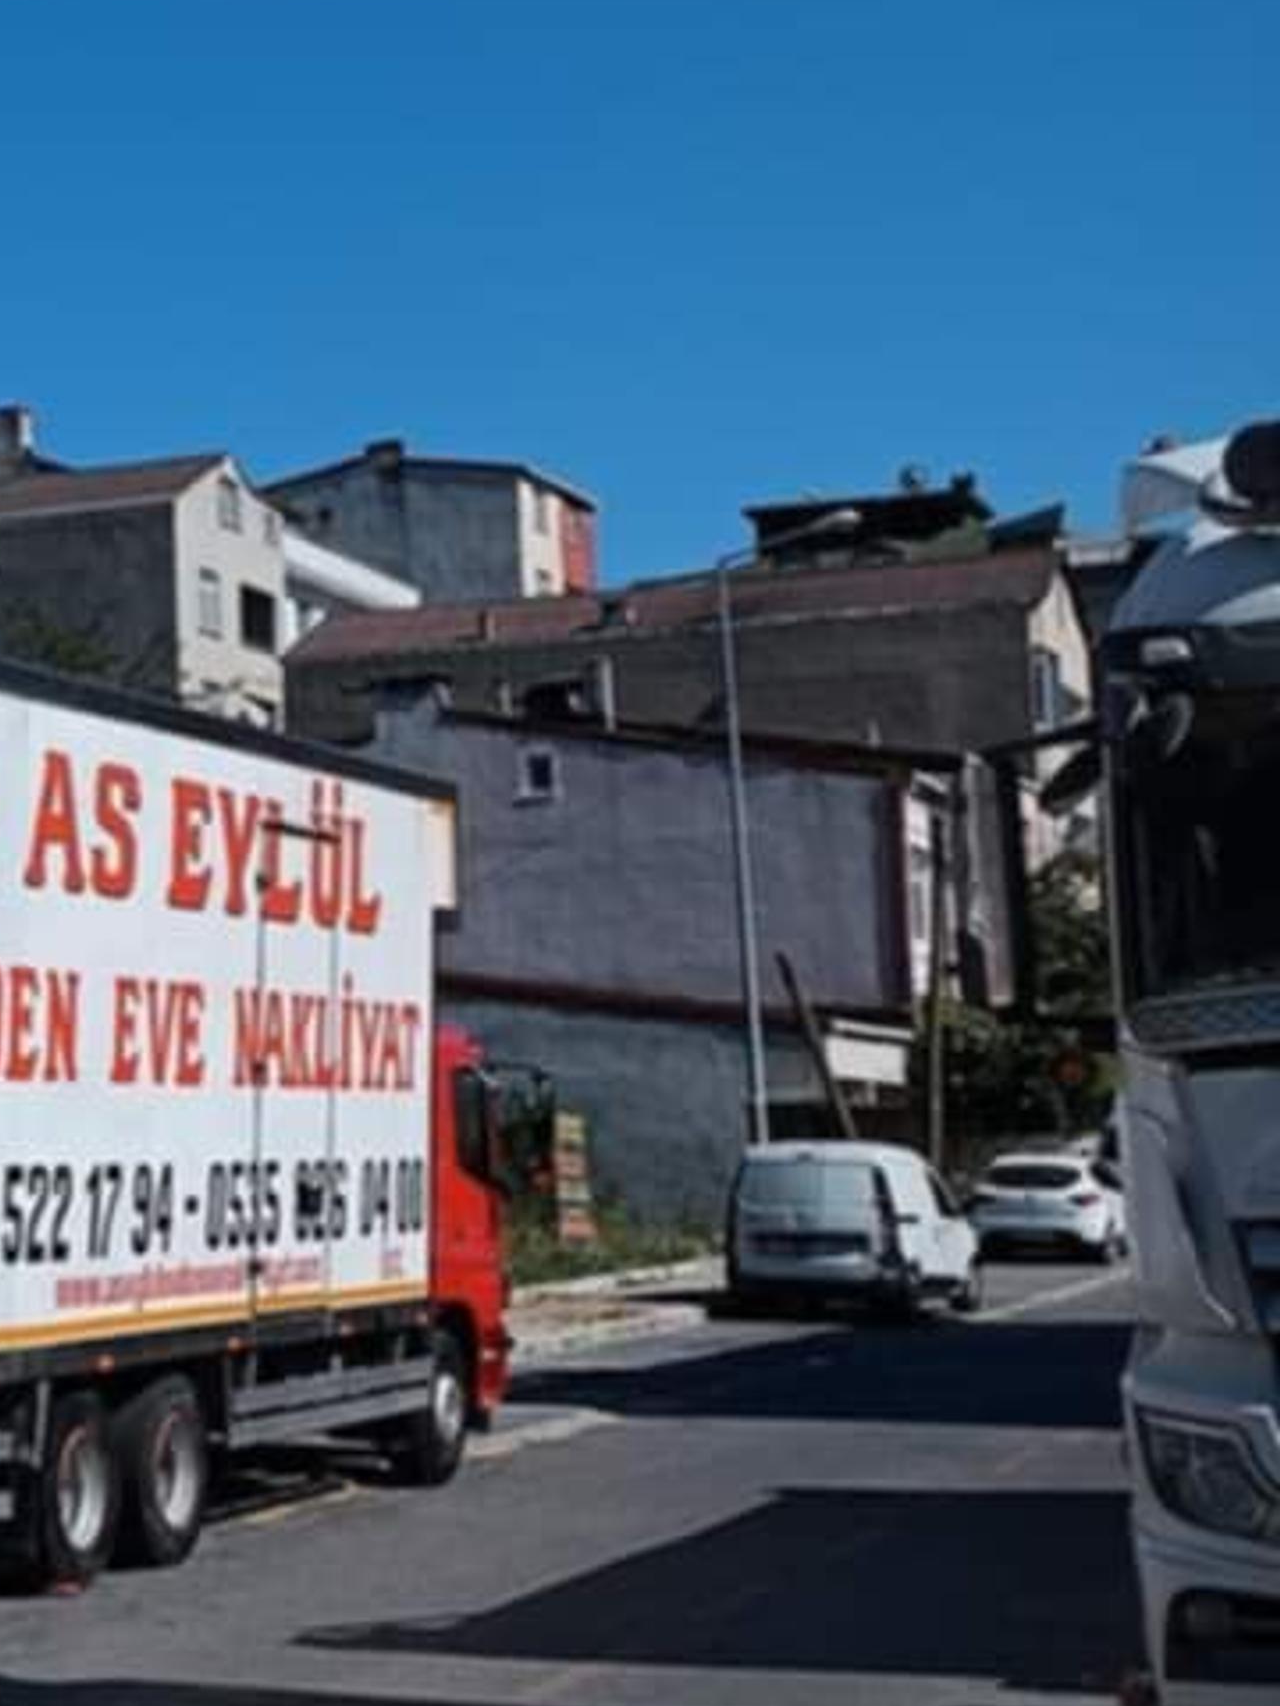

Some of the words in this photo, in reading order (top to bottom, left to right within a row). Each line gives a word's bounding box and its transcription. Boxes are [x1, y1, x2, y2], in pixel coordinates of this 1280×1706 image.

[24, 752, 141, 900] AS
[166, 777, 383, 935] EYLÜL
[110, 978, 205, 1087] EVE
[233, 971, 421, 1092] NAKLİYAT
[1, 1163, 74, 1266] 522
[85, 1163, 124, 1259] 17
[130, 1162, 174, 1257] 94
